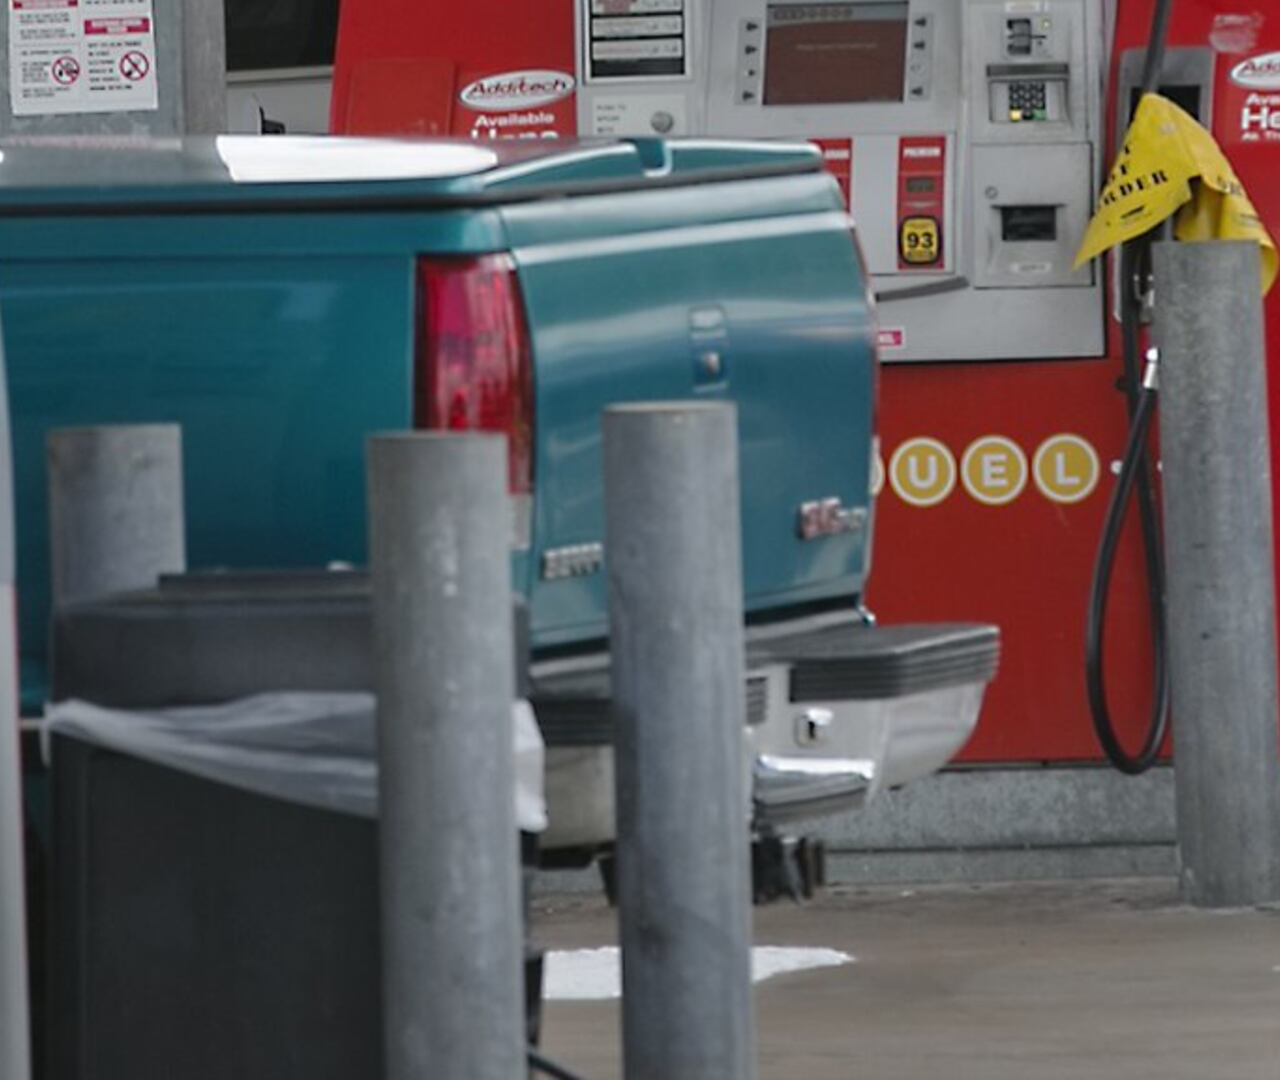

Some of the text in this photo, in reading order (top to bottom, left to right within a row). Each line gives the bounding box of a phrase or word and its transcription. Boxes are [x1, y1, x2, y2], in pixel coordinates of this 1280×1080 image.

[468, 75, 567, 99] Additech
[474, 110, 556, 129] Available
[1101, 169, 1169, 206] RDER
[906, 230, 934, 249] 93
[907, 453, 1080, 485] UEL
